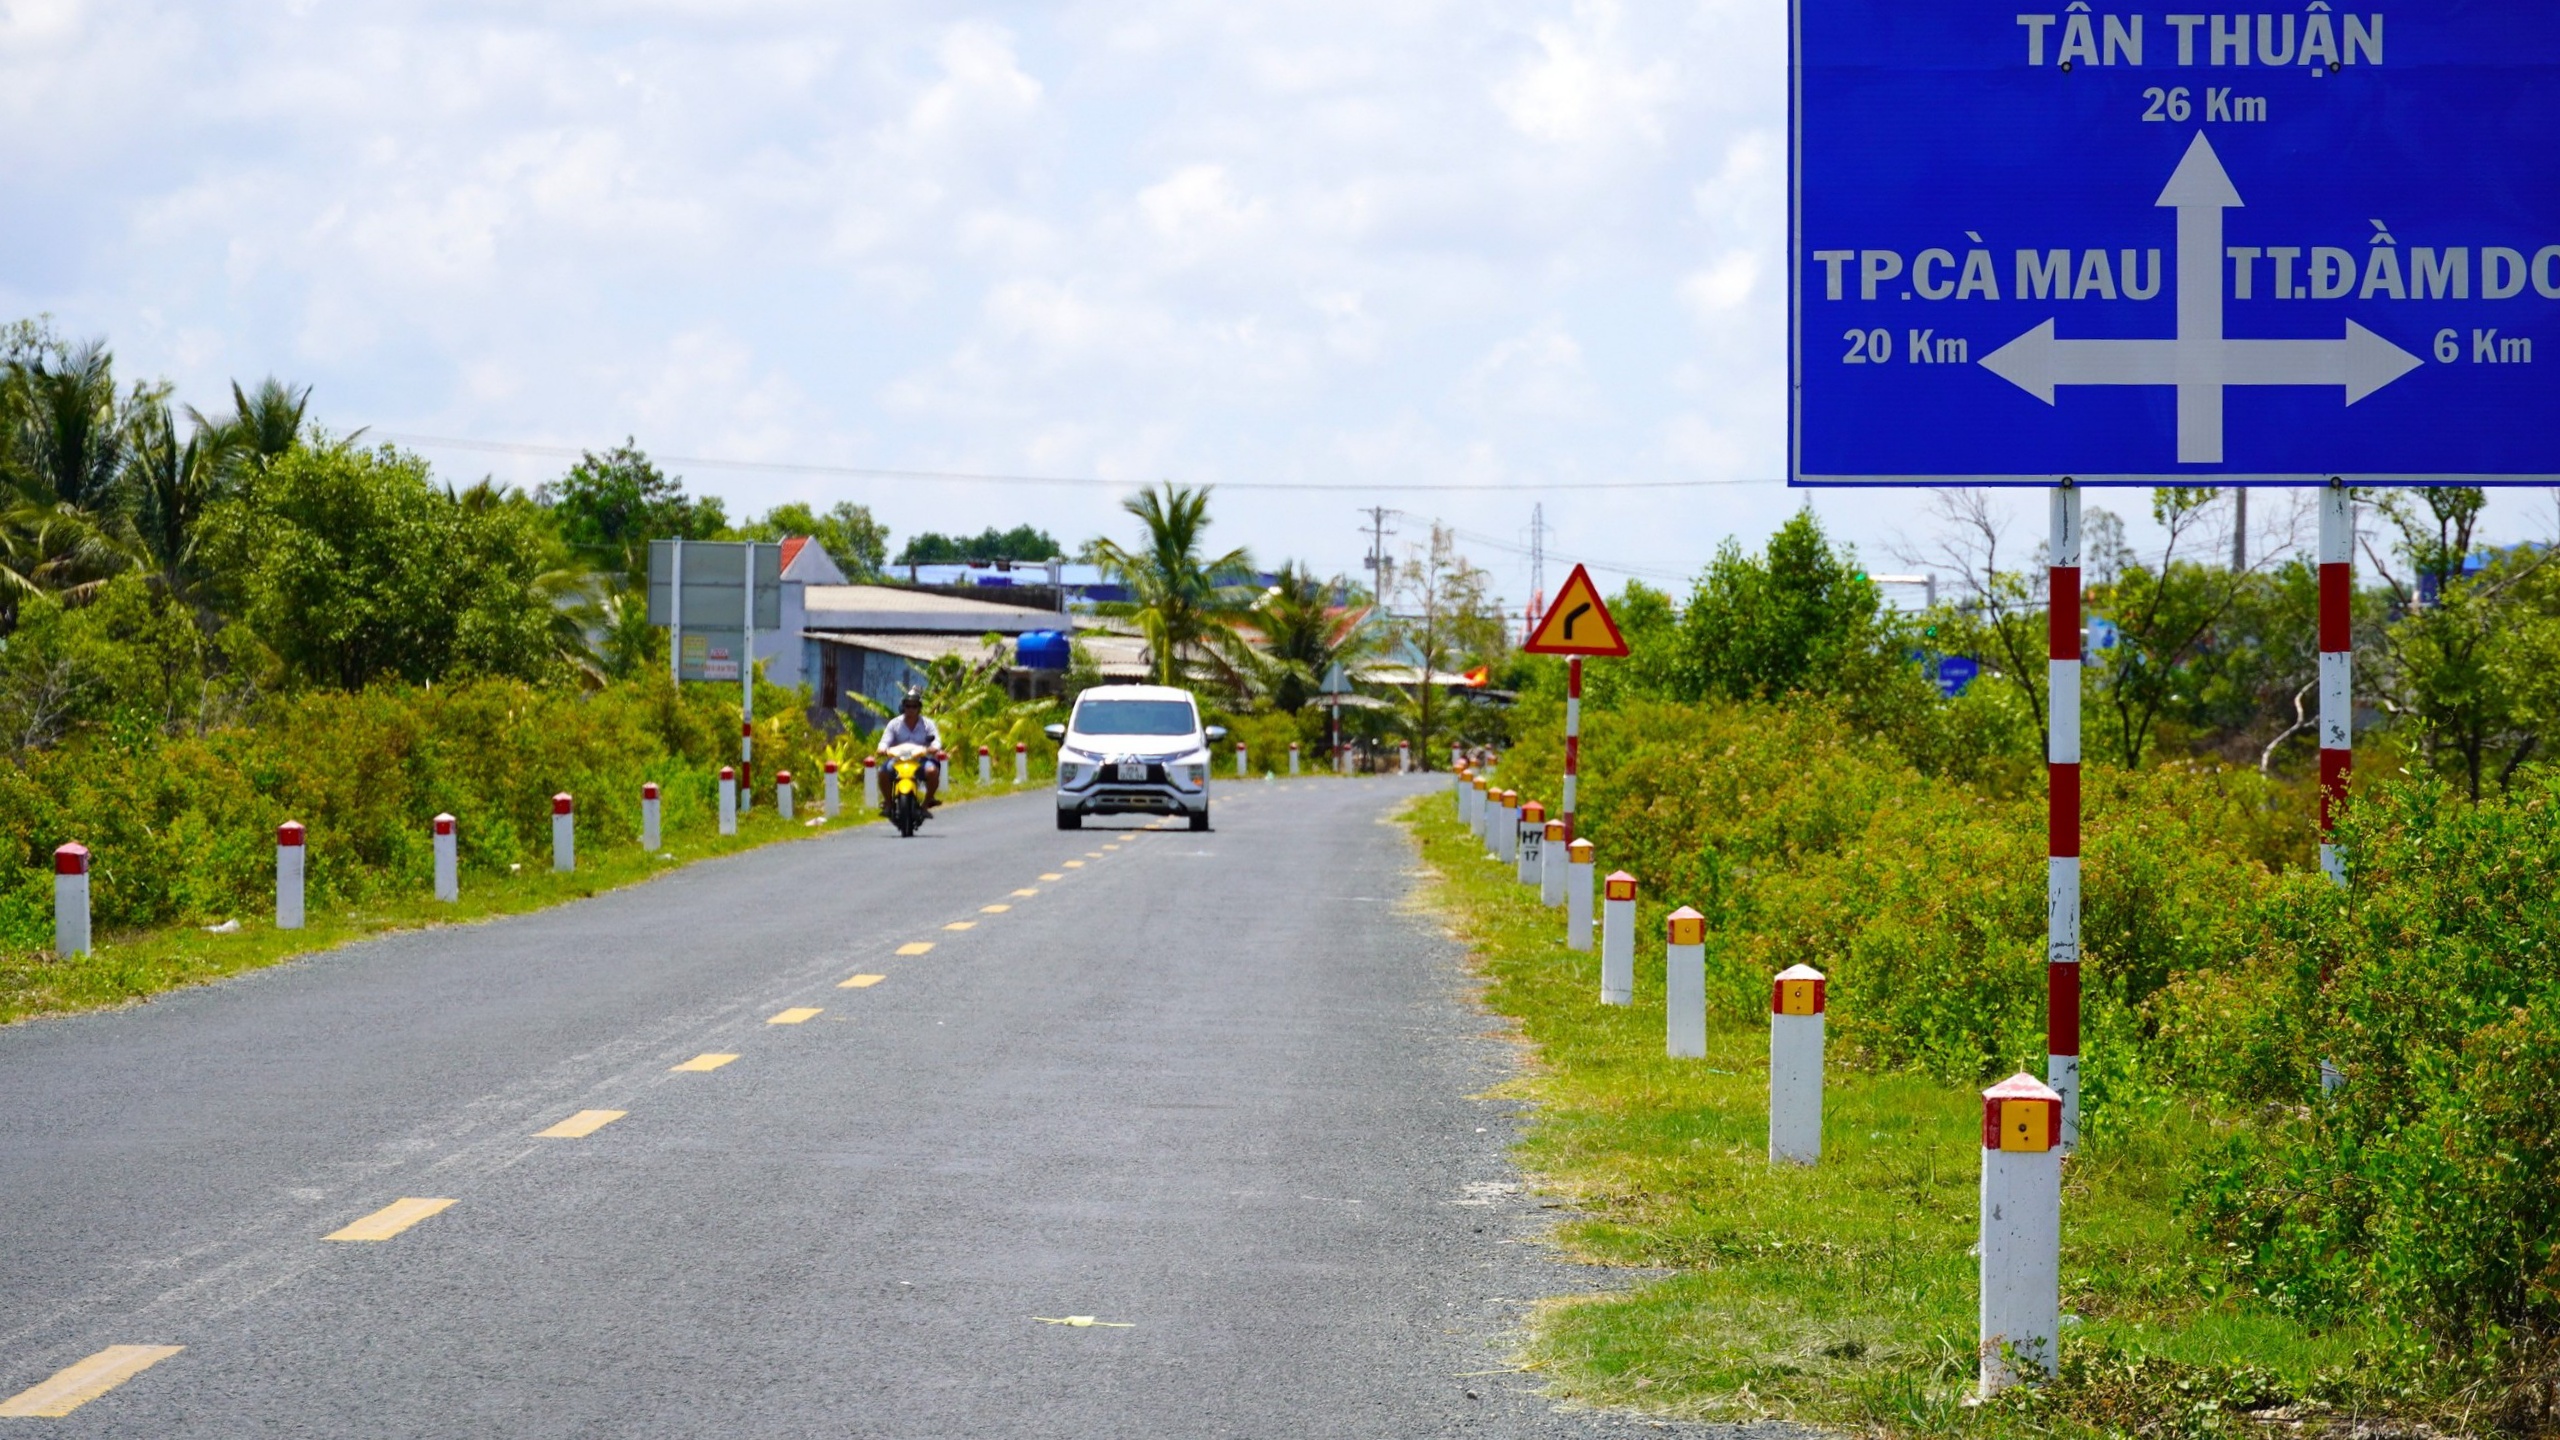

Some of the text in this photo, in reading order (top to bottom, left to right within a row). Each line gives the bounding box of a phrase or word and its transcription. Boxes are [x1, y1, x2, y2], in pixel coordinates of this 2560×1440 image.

[2017, 0, 2383, 78] TÂN THUẬN
[2142, 87, 2267, 122] 26 Km
[1814, 231, 2161, 301] TP.CÀ MAU
[2227, 219, 2469, 300] TT.ĐẦM
[1843, 329, 1968, 364] 20 Km
[2434, 329, 2532, 364] 6 Km
[1522, 830, 1543, 844] H7
[1524, 850, 1539, 861] 17
